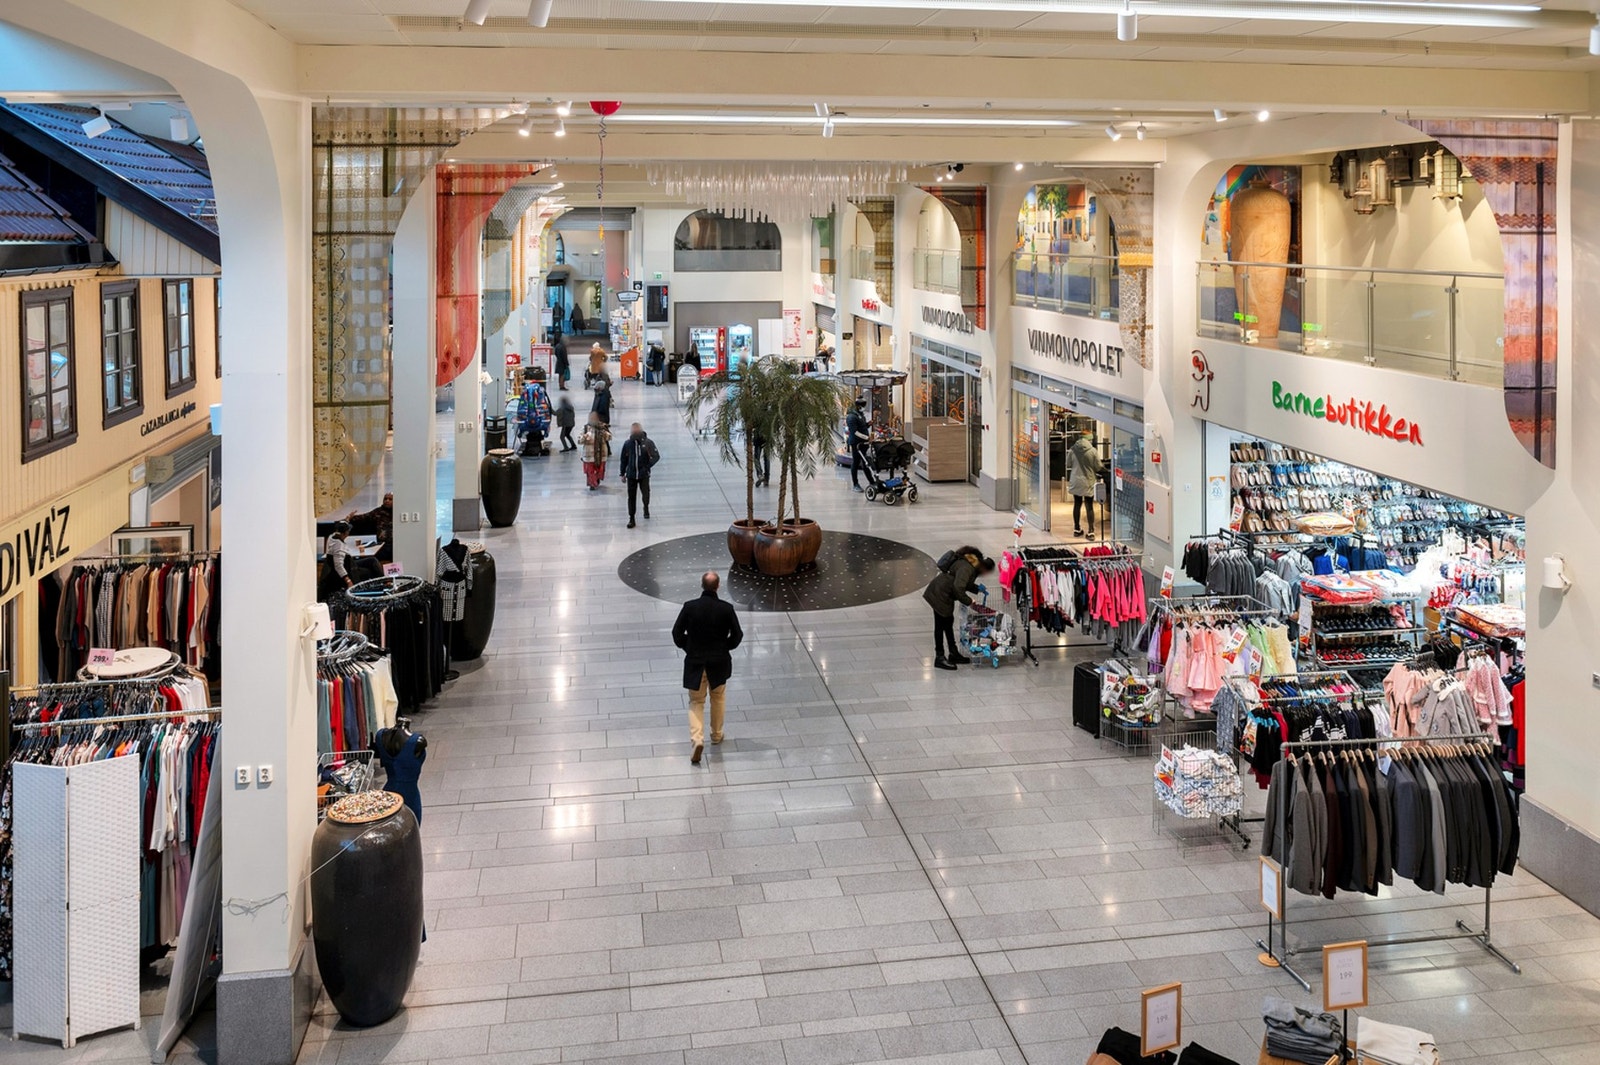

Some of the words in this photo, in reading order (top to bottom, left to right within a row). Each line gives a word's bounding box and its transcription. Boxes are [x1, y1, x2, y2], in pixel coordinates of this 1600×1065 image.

[921, 305, 974, 334] VINMONOPOLET
[1027, 328, 1123, 373] VINMONOPOLET
[1271, 380, 1424, 446] Barnebutikken
